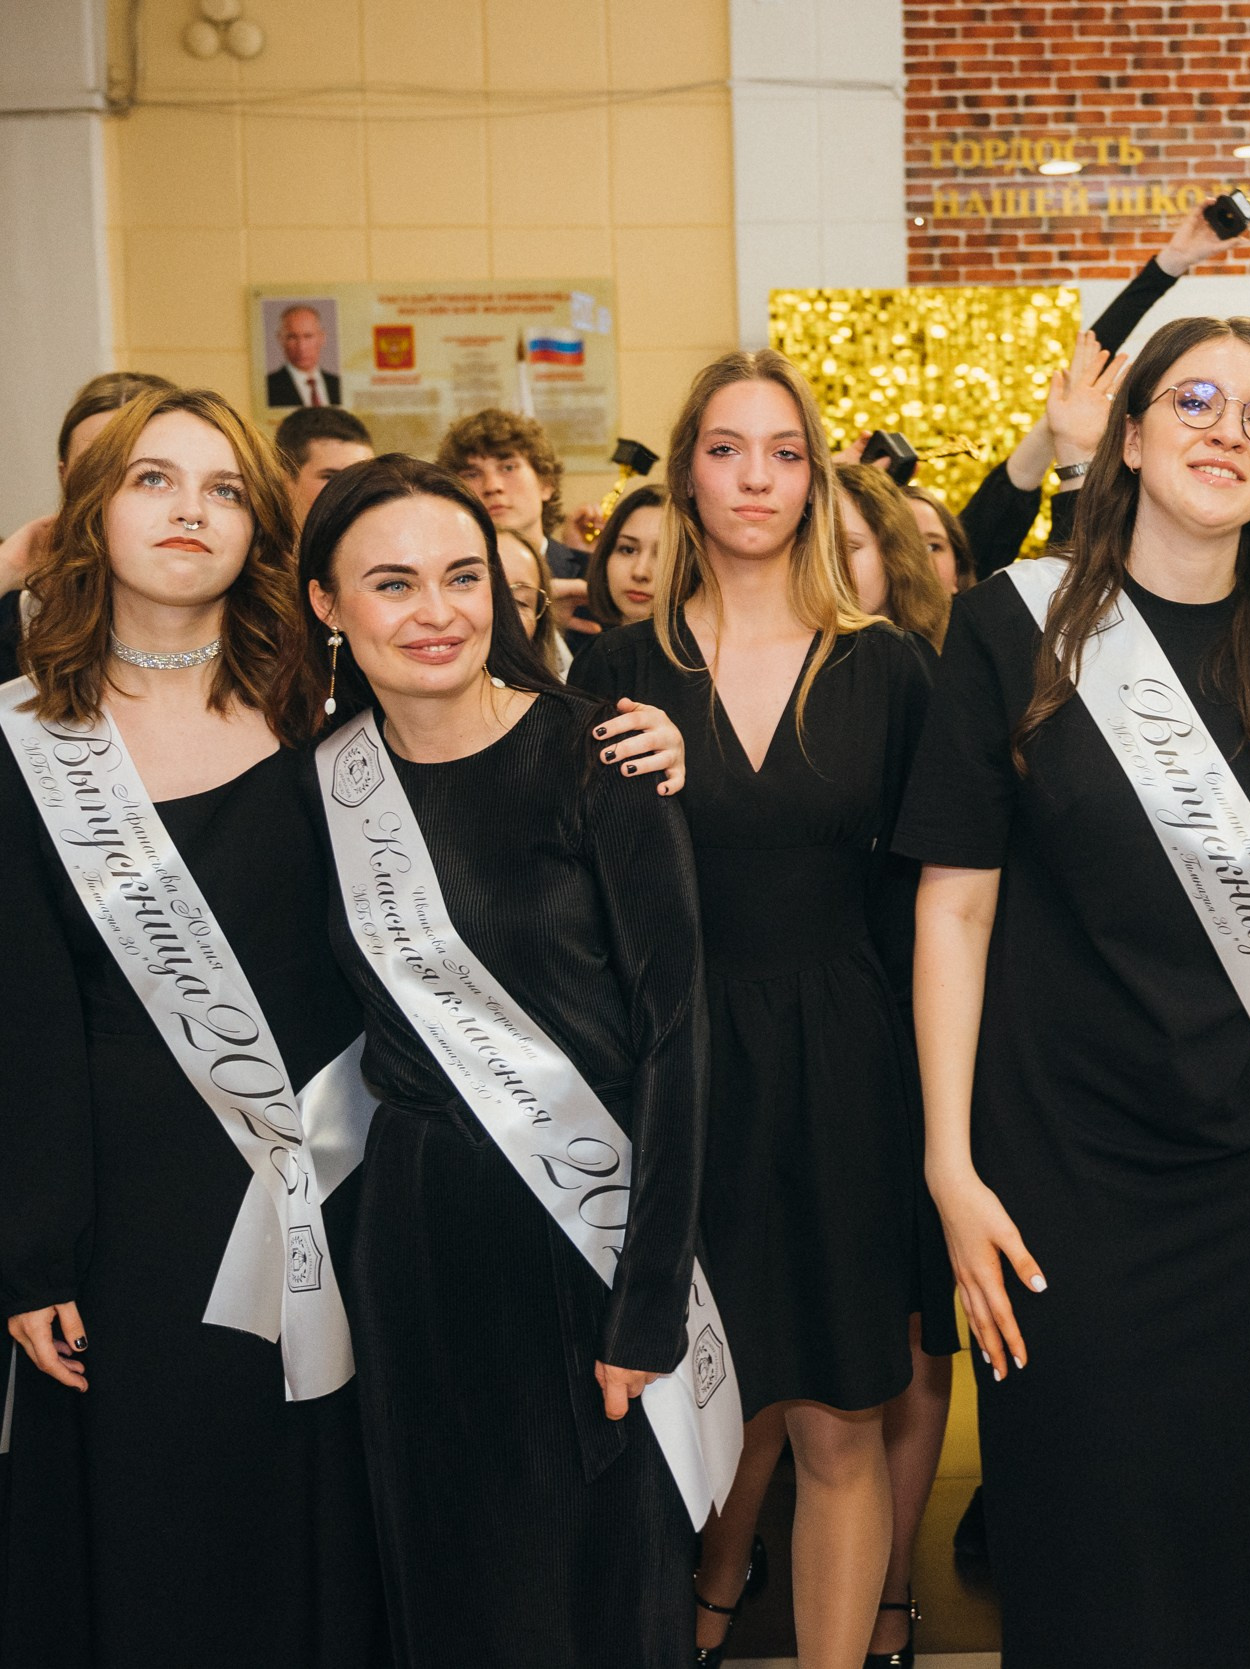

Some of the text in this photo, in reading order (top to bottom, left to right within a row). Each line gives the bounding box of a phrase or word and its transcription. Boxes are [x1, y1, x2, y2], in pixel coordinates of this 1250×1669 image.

[931, 135, 1144, 170] ГОРДОСТЬ
[933, 181, 1089, 218] НАШЕЙ
[20, 734, 65, 809] МБОУ
[1106, 716, 1158, 786] МБОУ
[39, 708, 212, 1003] Выпускница
[111, 782, 224, 972] Афанасьева Юлия
[351, 882, 385, 957] МБОУ
[362, 811, 440, 986] Классная
[433, 988, 552, 1128] классная
[413, 886, 537, 1060] Иванкова Яна Сергеевна
